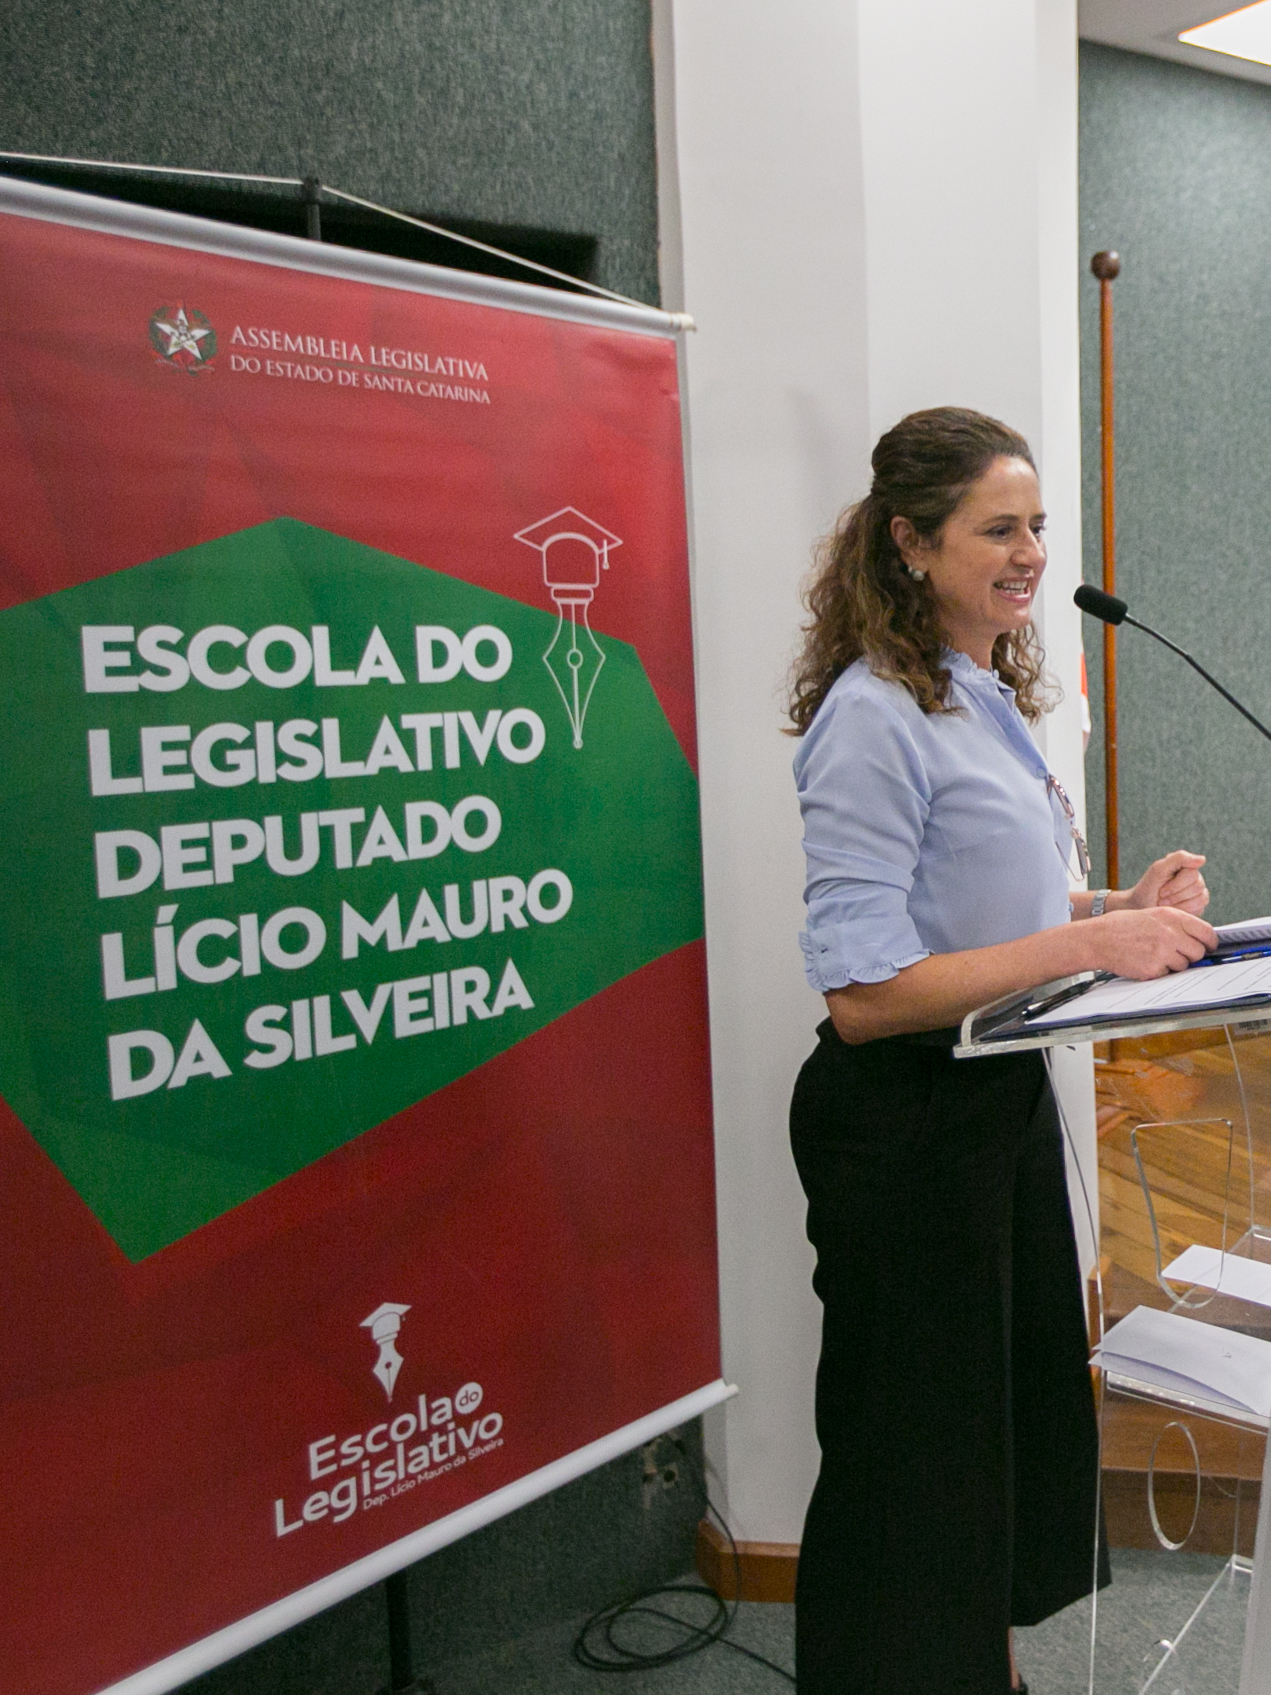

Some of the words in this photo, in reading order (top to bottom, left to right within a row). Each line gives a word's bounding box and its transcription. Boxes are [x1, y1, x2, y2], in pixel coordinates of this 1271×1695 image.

[230, 325, 364, 363] ASSEMBLEIA
[370, 345, 489, 381] LEGISLATIVA
[230, 354, 261, 374] DO
[266, 359, 333, 384] ESTADO
[338, 370, 359, 388] DE
[364, 373, 414, 396] SANTA
[416, 380, 491, 404] CATARINA
[81, 624, 406, 693] ESCOLA
[415, 624, 513, 684] DO
[87, 707, 546, 797] LEGISLATIVO
[94, 794, 502, 899] DEPUTADO
[100, 903, 327, 1001] LÍCIO
[341, 868, 573, 960] MAURO
[107, 1017, 233, 1101] DA
[243, 957, 536, 1070] SILVEIRA
[274, 1412, 503, 1538] Legislativo
[308, 1393, 453, 1481] Escola
[363, 1493, 389, 1511] Dep.
[417, 1462, 453, 1484] Mauro
[453, 1454, 467, 1468] da
[468, 1437, 504, 1461] Silveira
